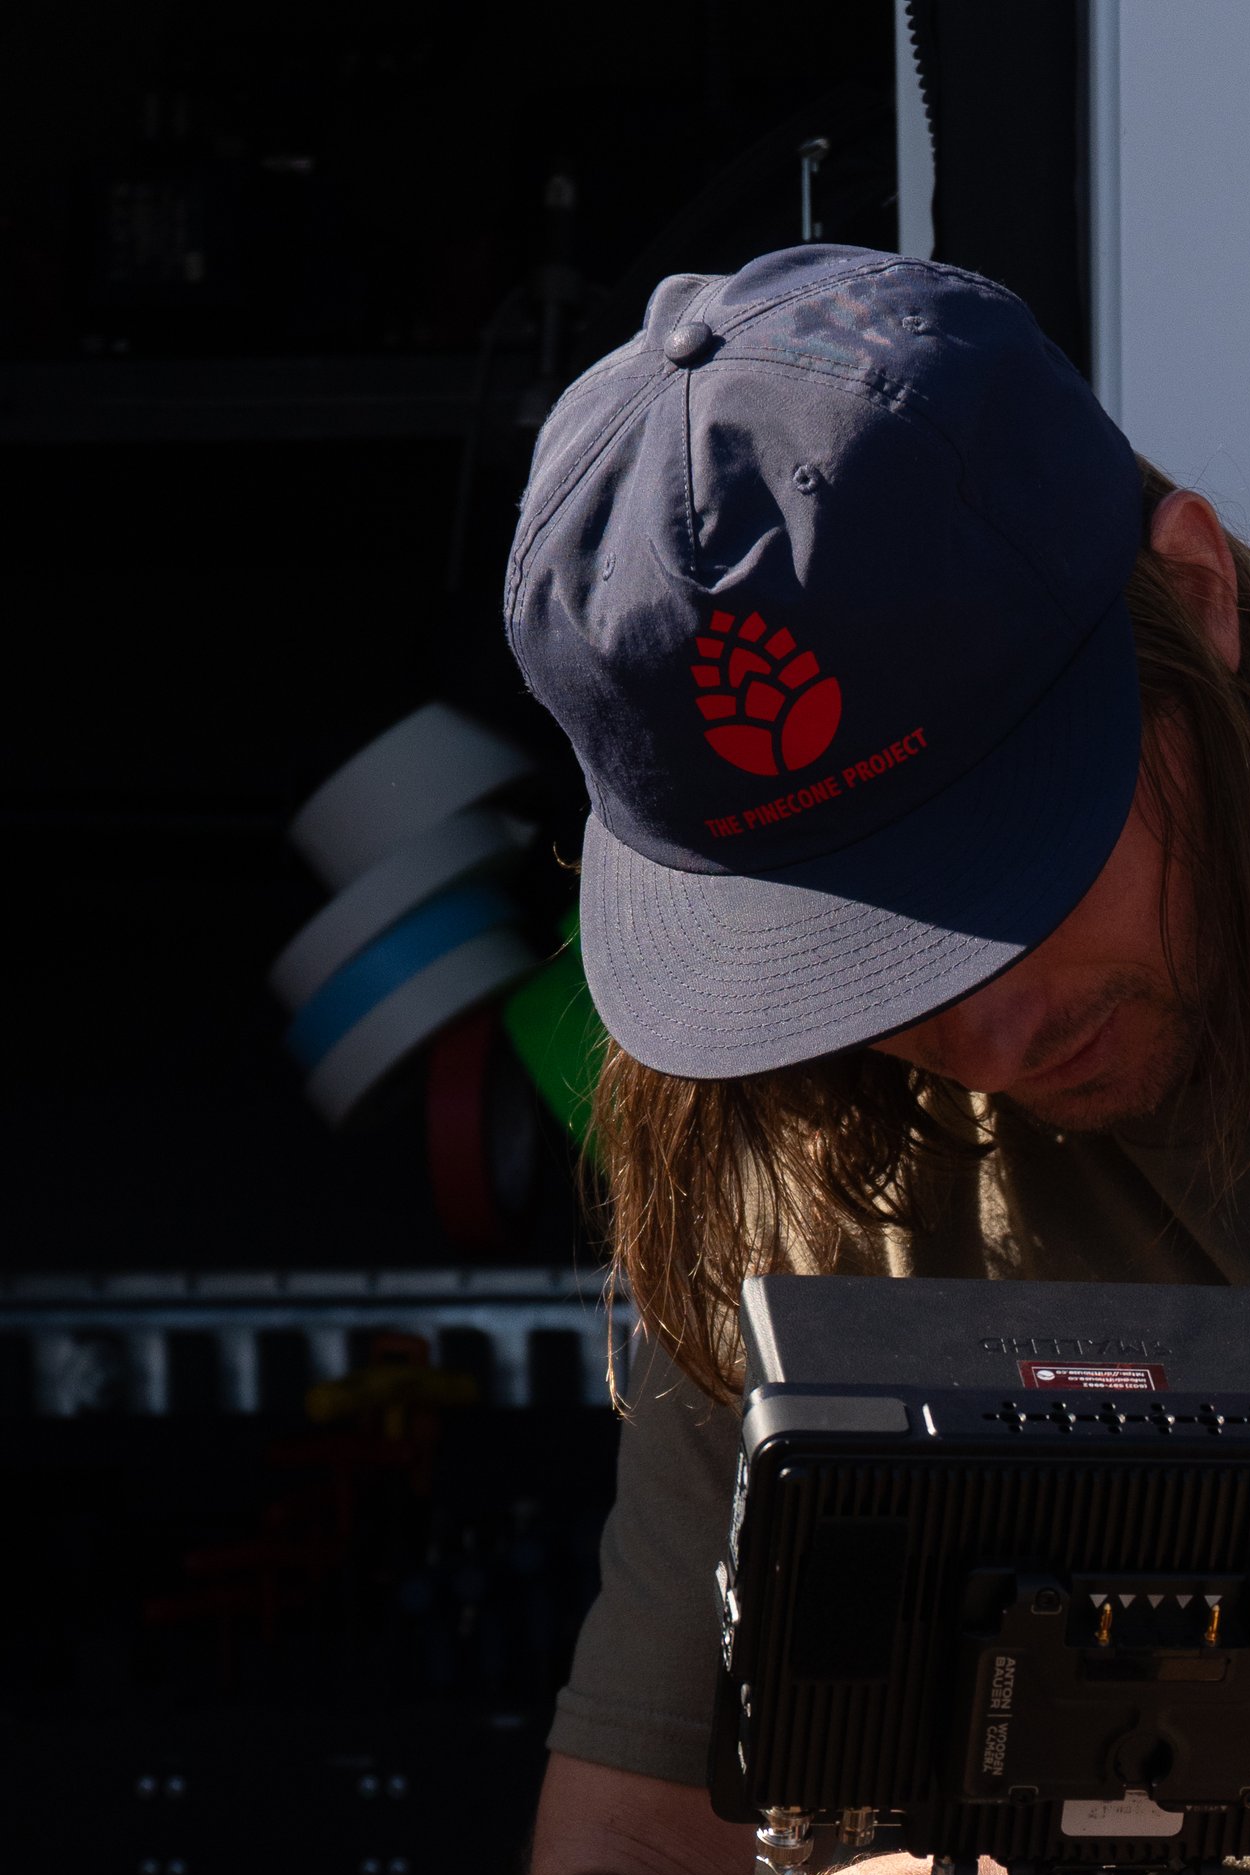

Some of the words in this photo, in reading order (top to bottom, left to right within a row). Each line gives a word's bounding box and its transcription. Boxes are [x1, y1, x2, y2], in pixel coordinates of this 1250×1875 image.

[706, 815, 743, 839] THE
[743, 776, 841, 831] PINECONE
[843, 727, 930, 789] PROJECT
[990, 1656, 1006, 1709] BAUER
[1000, 1656, 1017, 1710] ANTON
[982, 1725, 998, 1773] CAMERA
[991, 1722, 1009, 1776] WOODEN
